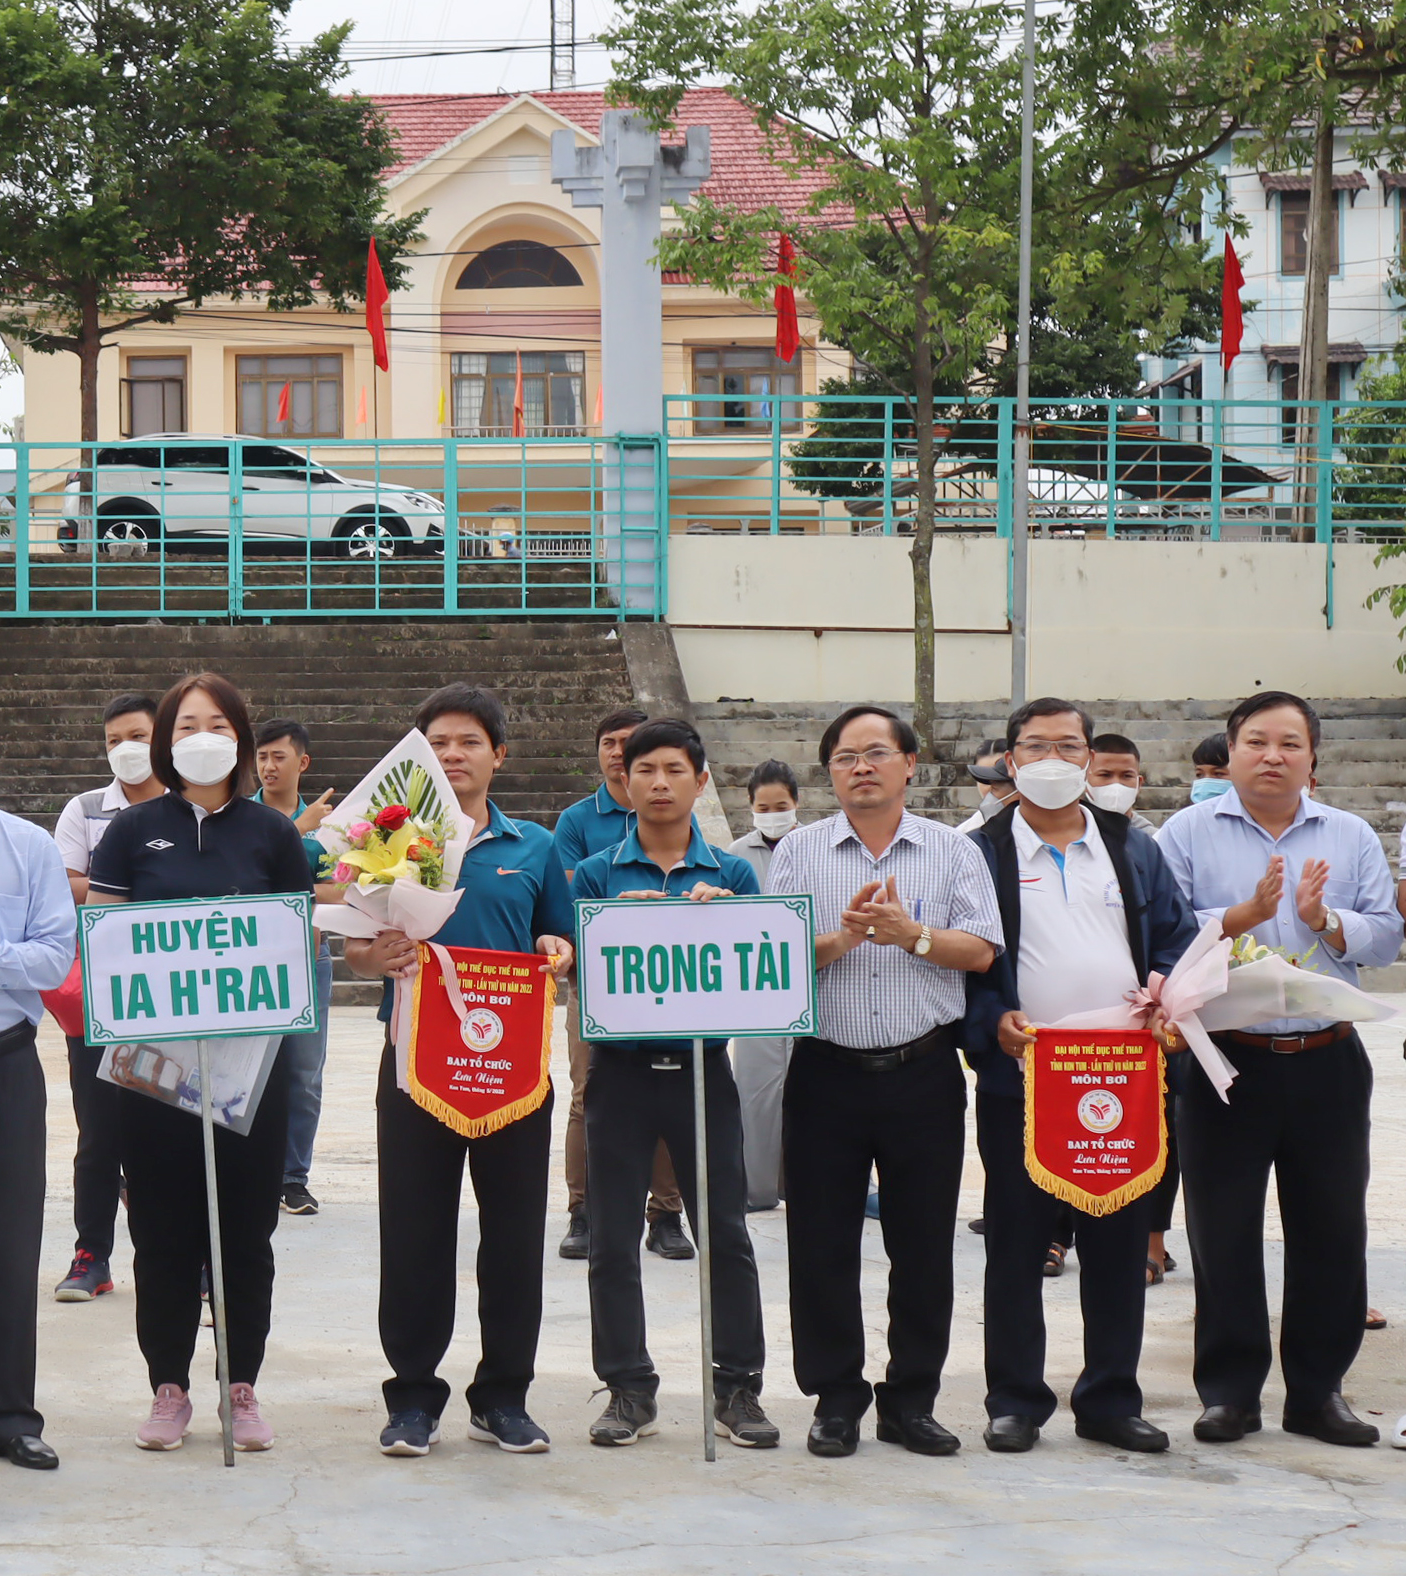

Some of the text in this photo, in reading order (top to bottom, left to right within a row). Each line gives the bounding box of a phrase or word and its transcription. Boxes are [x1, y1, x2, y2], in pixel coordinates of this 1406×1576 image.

[132, 911, 258, 956] HUYỆN
[513, 968, 530, 977] THAO
[601, 931, 790, 1005] TRỌNG TÀI
[111, 964, 290, 1020] IA H'RAI
[490, 996, 512, 1005] BƠI
[1126, 1046, 1143, 1054] THAO
[447, 1055, 512, 1070] BAN TỔ CHỨC
[1072, 1074, 1127, 1085] MÔN BƠI
[1068, 1136, 1135, 1149] BAN TỔ CHỨC
